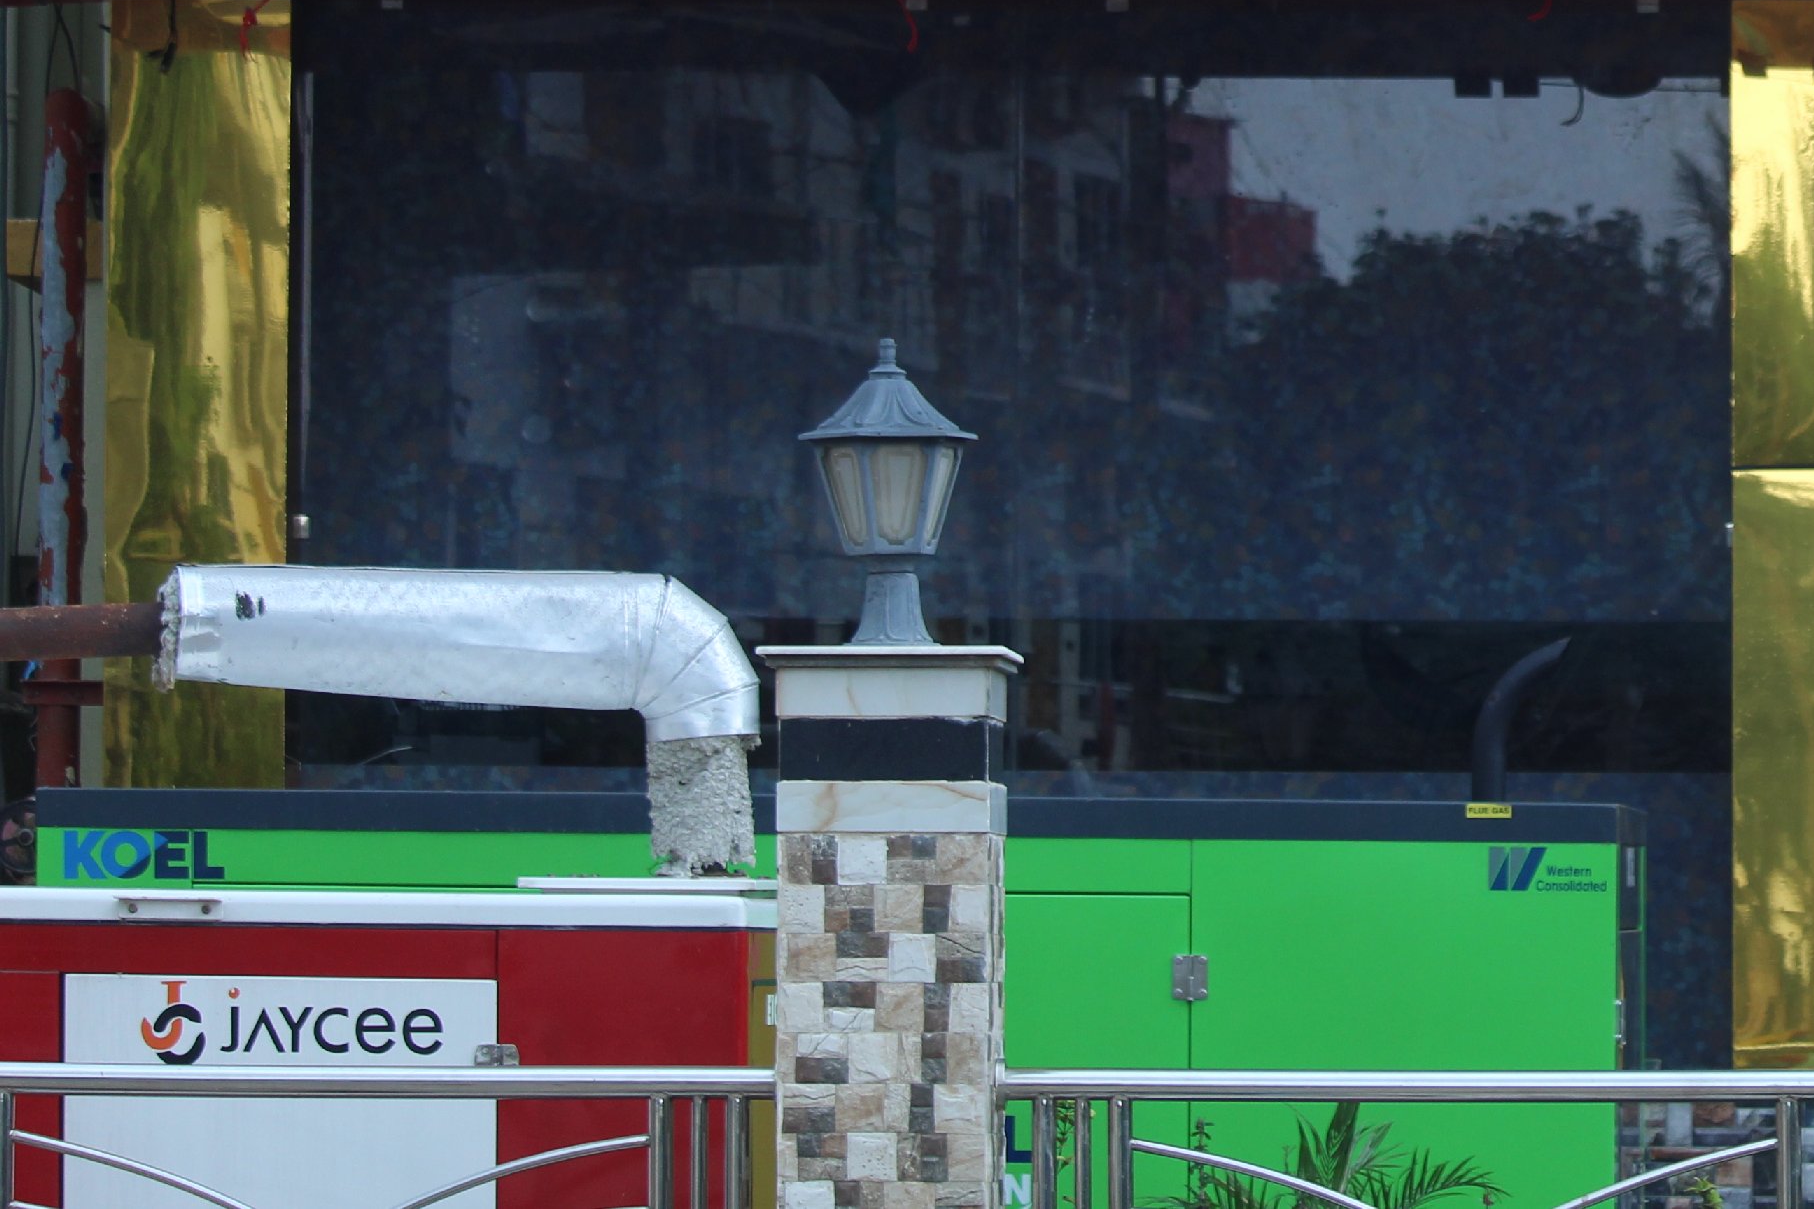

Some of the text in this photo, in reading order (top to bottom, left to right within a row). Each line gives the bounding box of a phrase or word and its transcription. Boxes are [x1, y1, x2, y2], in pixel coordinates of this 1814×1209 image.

[63, 830, 226, 880] KOEL
[1547, 866, 1592, 877] Western
[1536, 880, 1608, 892] Consolidated
